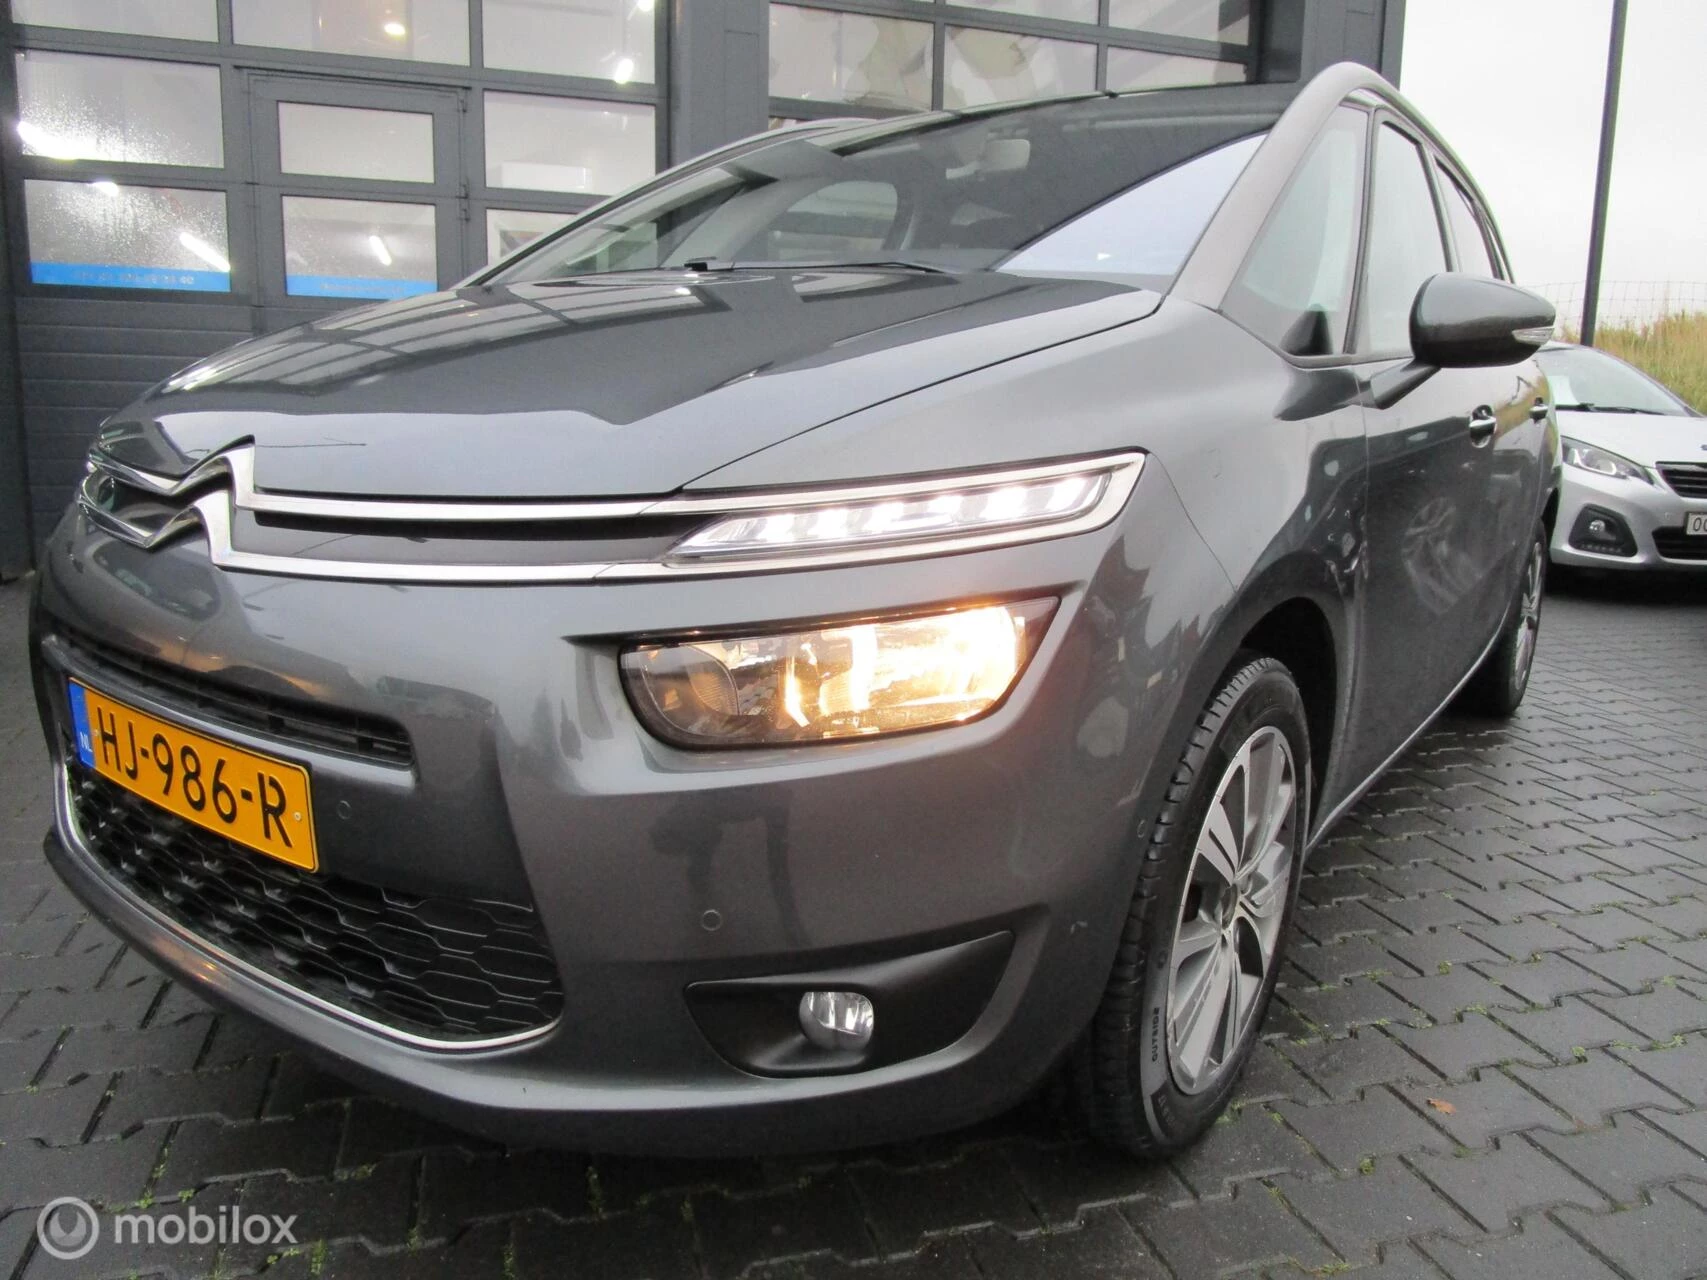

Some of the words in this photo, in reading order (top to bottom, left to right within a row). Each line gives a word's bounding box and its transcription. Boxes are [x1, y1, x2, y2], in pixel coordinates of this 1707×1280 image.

[80, 731, 93, 752] NL
[97, 706, 292, 848] HJ-986-R
[1151, 1007, 1160, 1062] OUTSIDE
